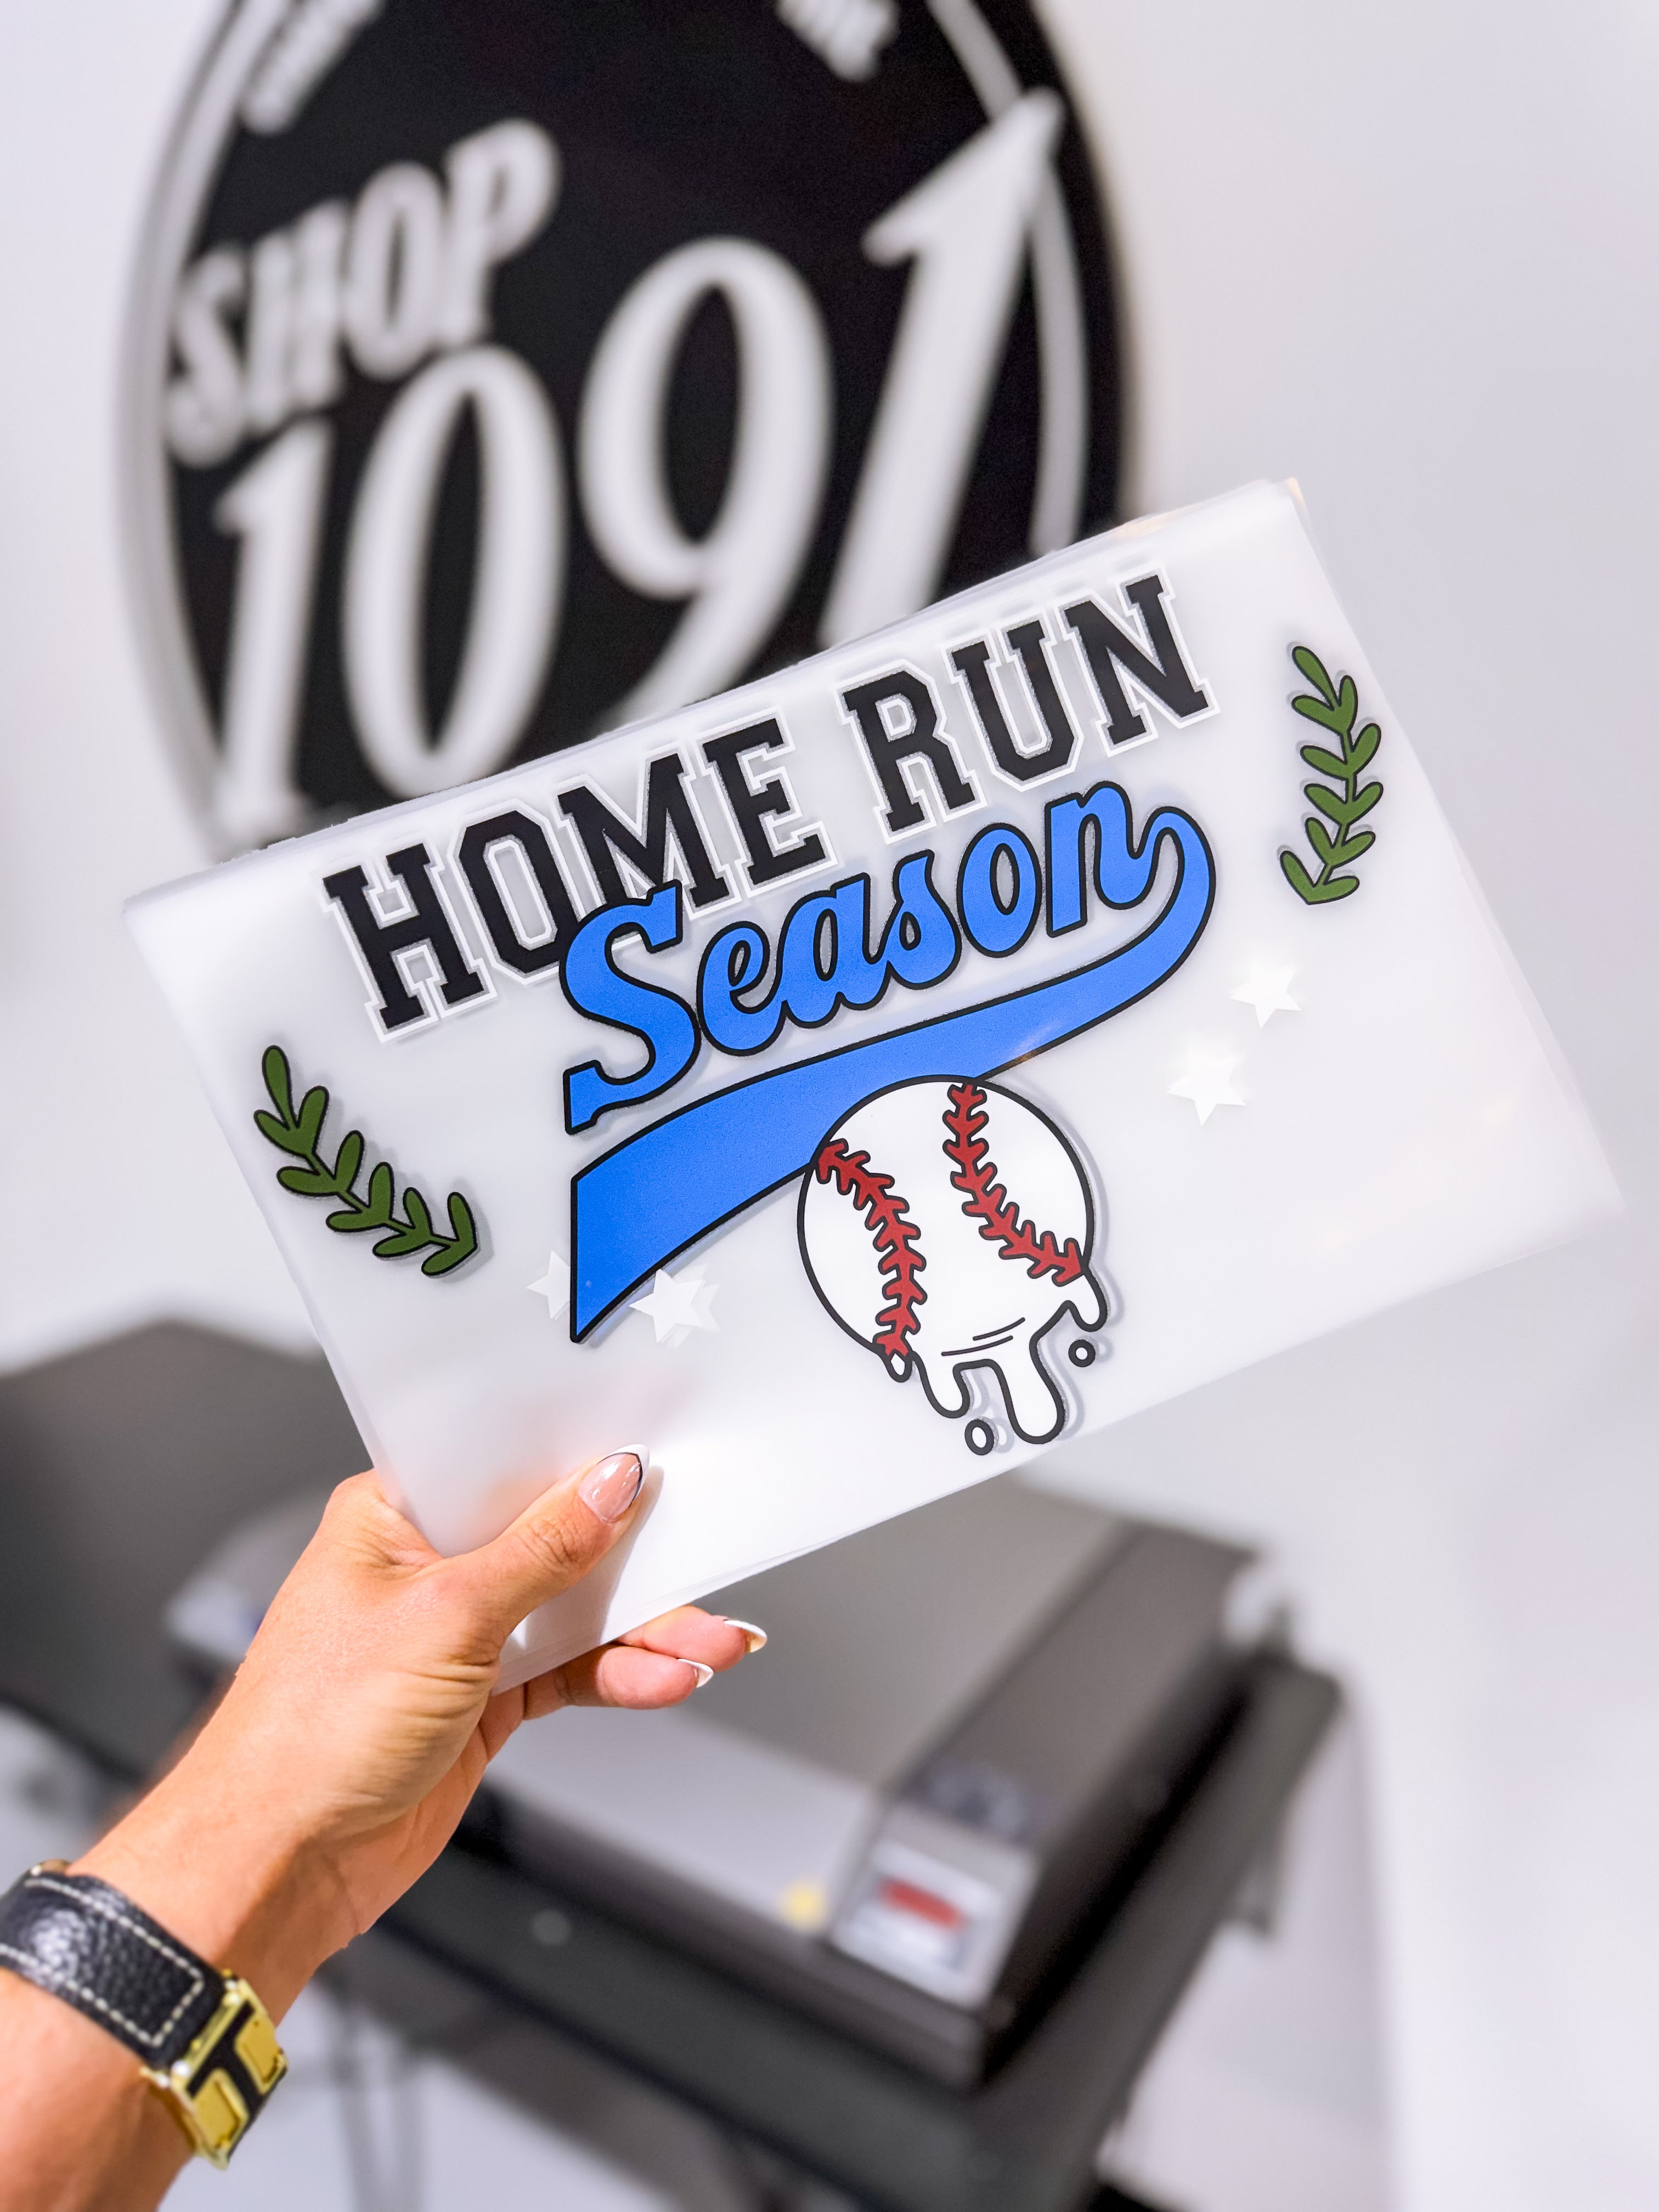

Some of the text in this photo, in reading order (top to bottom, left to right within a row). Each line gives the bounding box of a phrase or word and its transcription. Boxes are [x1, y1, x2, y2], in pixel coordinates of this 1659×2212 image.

[165, 117, 564, 467] SHOP
[213, 86, 1065, 846] 1091
[321, 572, 1214, 1035] HOME RUN
[562, 779, 1215, 1136] Season
